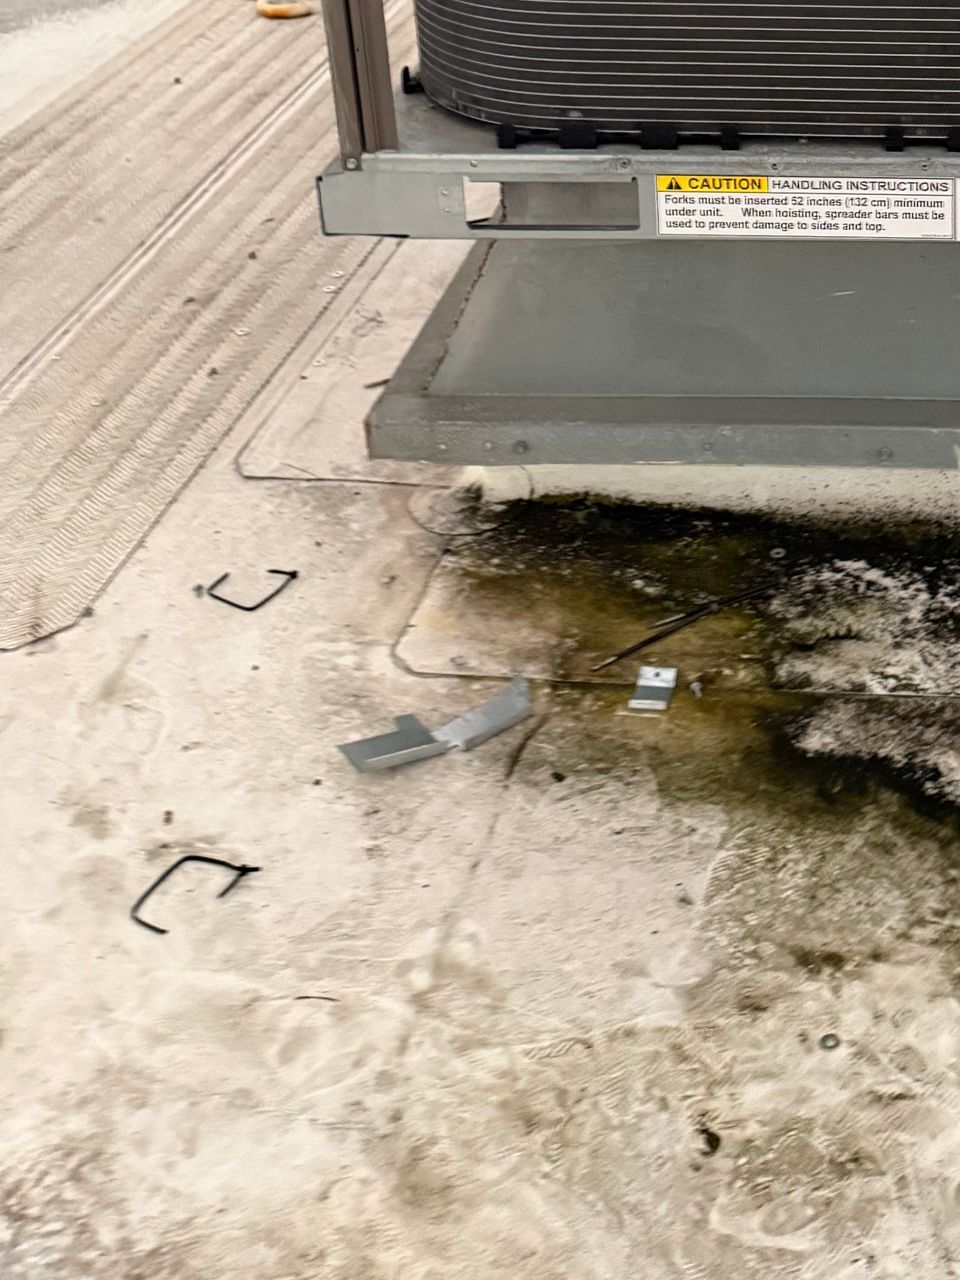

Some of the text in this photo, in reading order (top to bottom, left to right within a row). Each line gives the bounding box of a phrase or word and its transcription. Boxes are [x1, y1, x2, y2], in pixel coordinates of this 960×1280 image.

[688, 178, 949, 192] CAUTION HANDLING INSTRUCTIONS
[664, 195, 943, 209] Forks must be inserted 52 inches (132 cm) minimum
[665, 207, 945, 221] under unit. When hoisting, spreader bars must be
[665, 219, 886, 233] used to prevent damage to sides and top.
